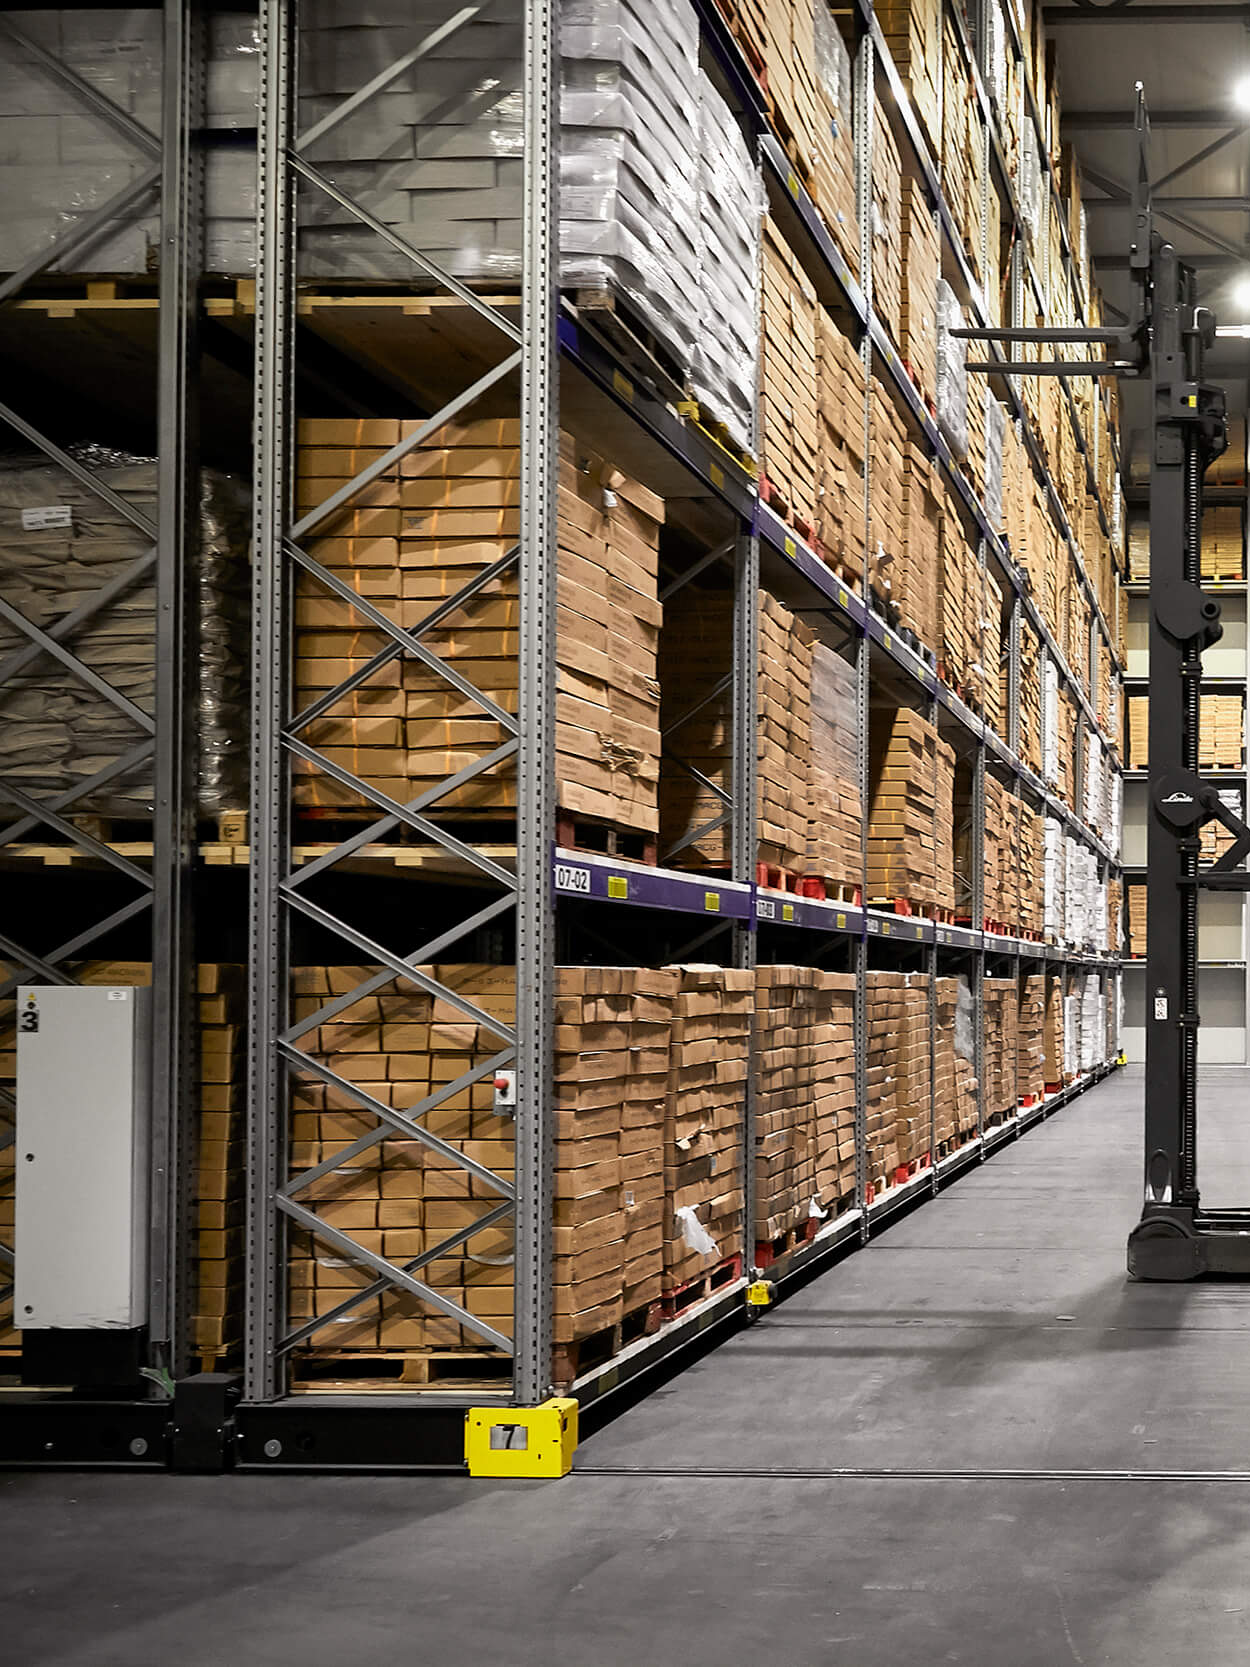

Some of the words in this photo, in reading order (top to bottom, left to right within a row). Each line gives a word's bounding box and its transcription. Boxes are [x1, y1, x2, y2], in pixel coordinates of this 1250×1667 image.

[557, 867, 587, 891] 07-02
[21, 1010, 39, 1032] 3
[502, 1424, 515, 1450] 7
